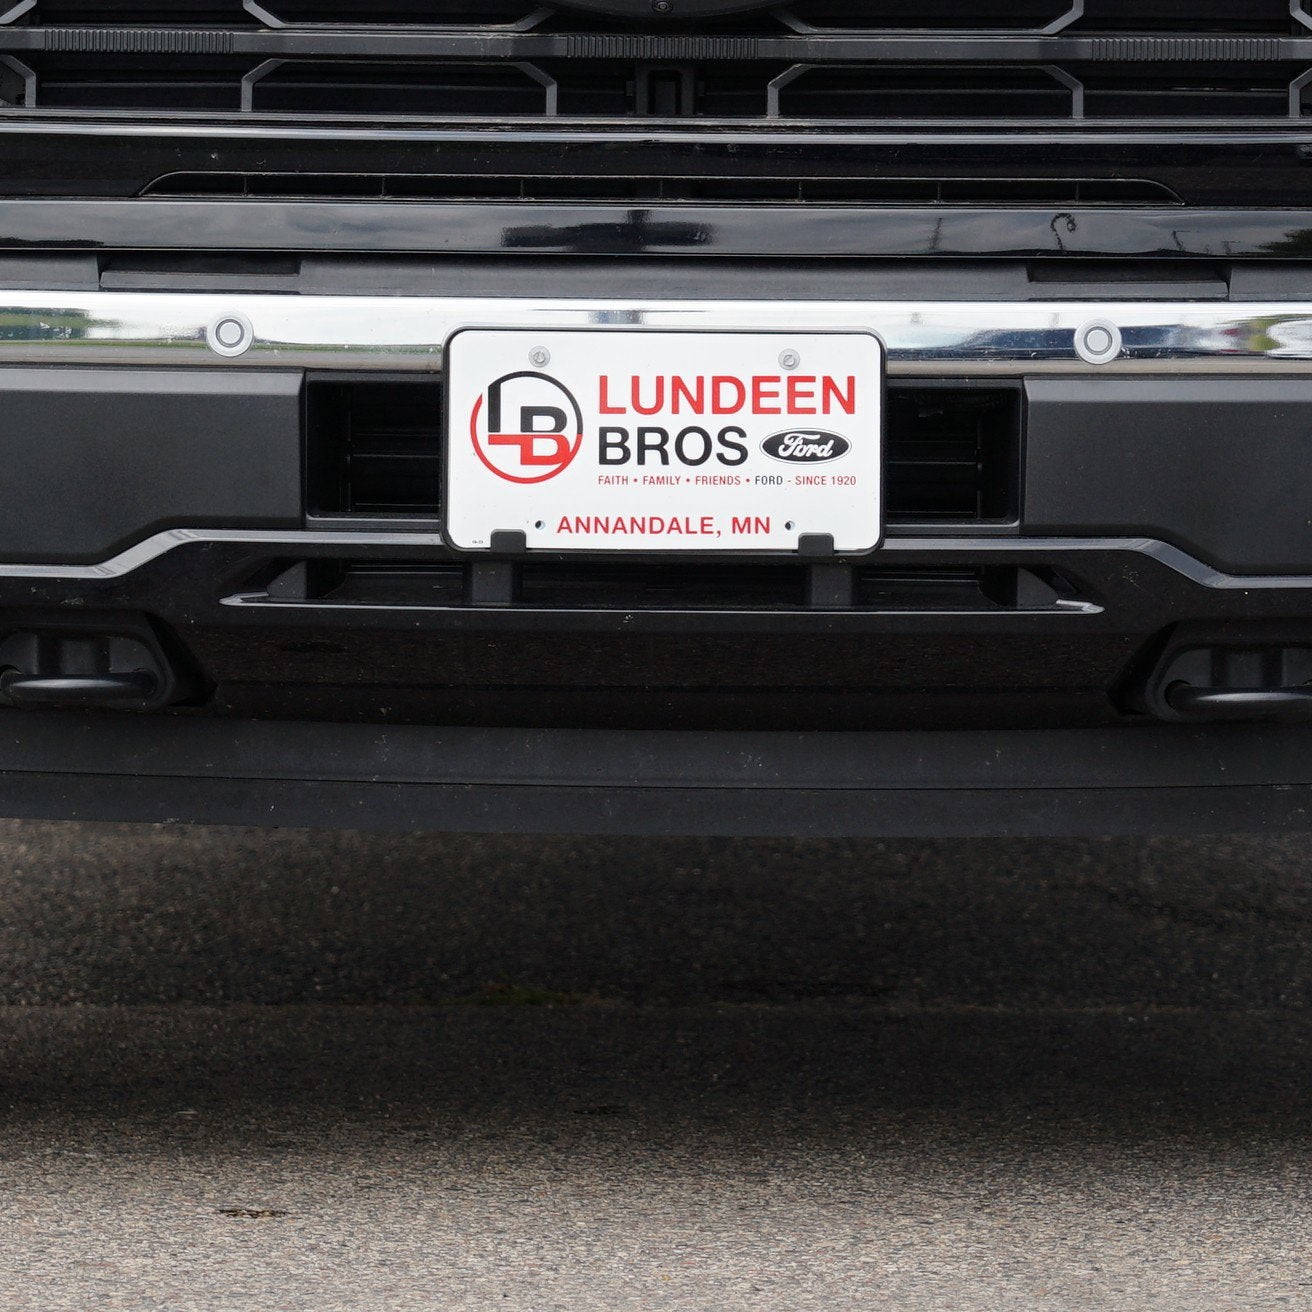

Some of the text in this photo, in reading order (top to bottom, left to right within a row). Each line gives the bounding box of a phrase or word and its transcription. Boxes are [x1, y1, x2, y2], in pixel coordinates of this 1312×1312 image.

[598, 375, 856, 415] LUNDEEN
[598, 426, 749, 466] BROS
[778, 433, 835, 457] Ford
[598, 475, 857, 486] FAITH FAMILY FRIENDS FORD SINCE 1920
[556, 516, 771, 537] ANNANDALE, MN
